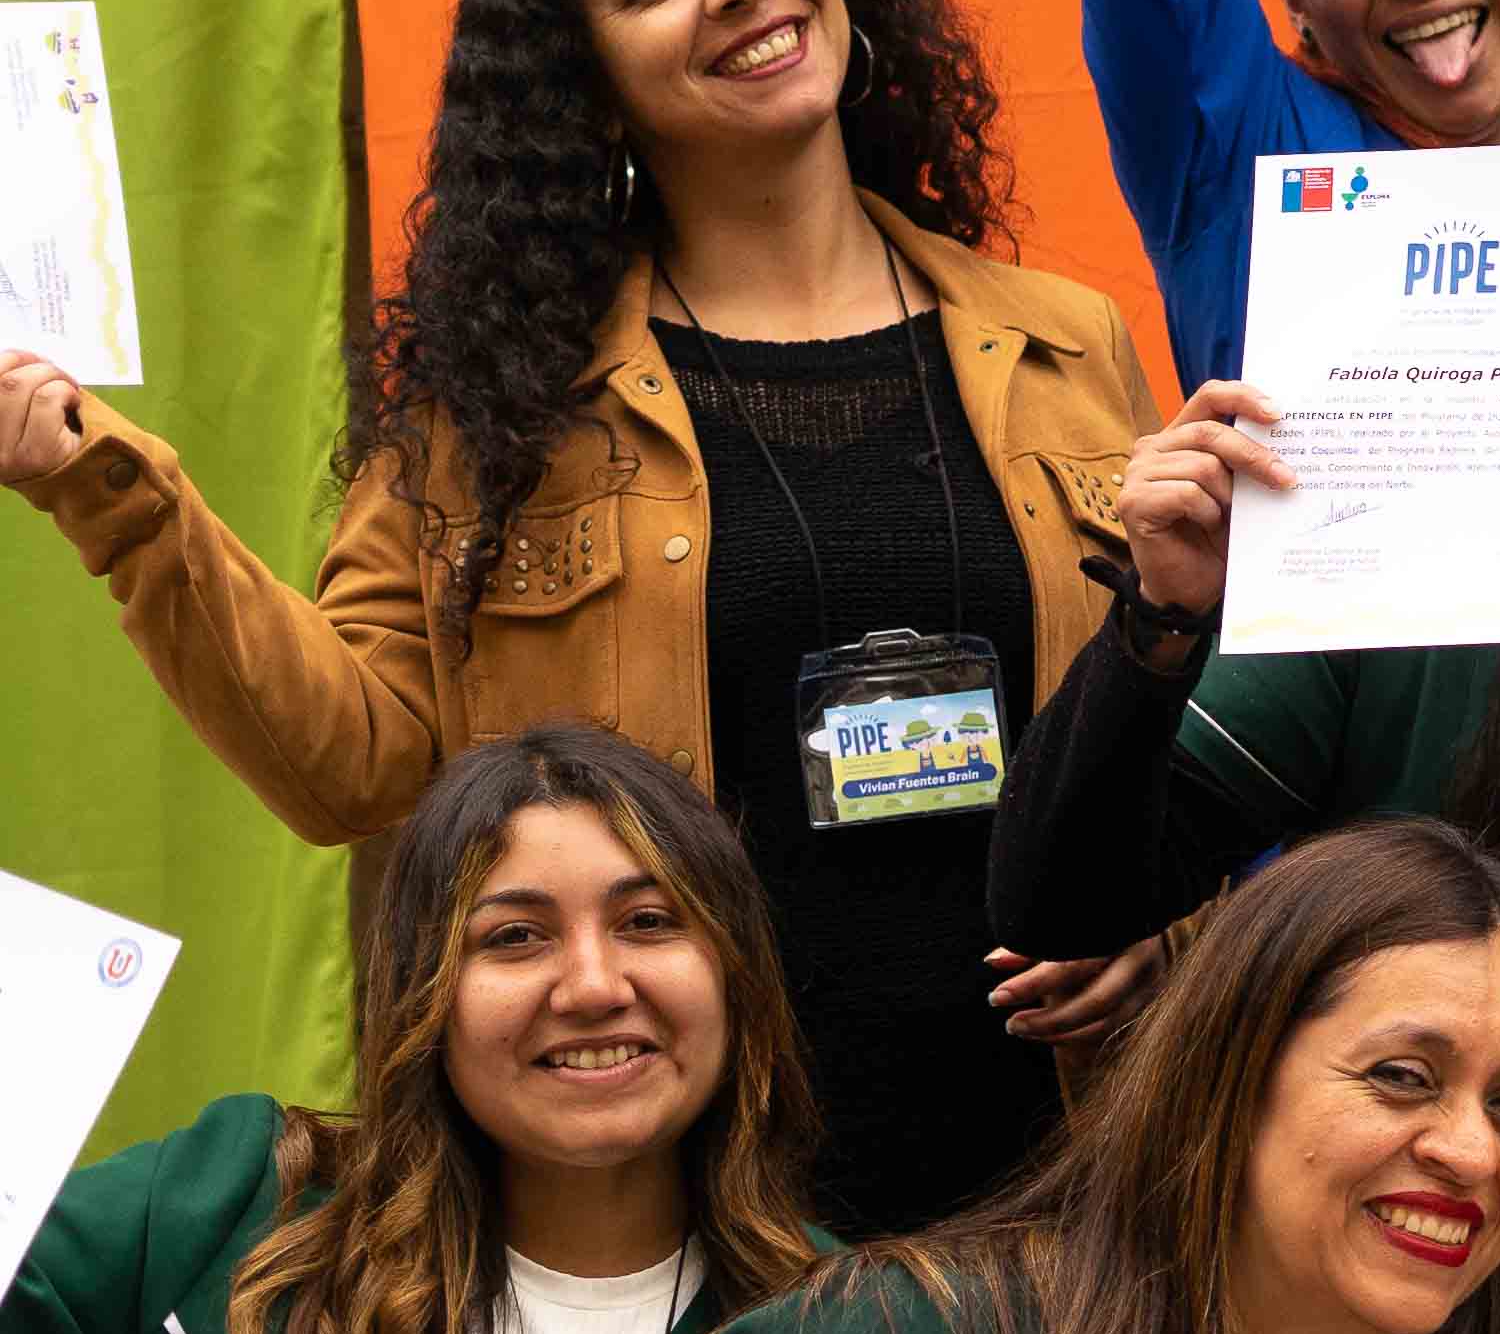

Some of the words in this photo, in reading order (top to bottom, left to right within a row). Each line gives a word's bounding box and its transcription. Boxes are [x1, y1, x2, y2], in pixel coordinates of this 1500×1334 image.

[1404, 240, 1500, 295] PIPE
[1328, 366, 1399, 380] Fabiola
[1406, 366, 1483, 384] Quiroga
[838, 722, 892, 759] PIPE
[859, 781, 896, 795] Vivian
[898, 774, 945, 791] Fuentes
